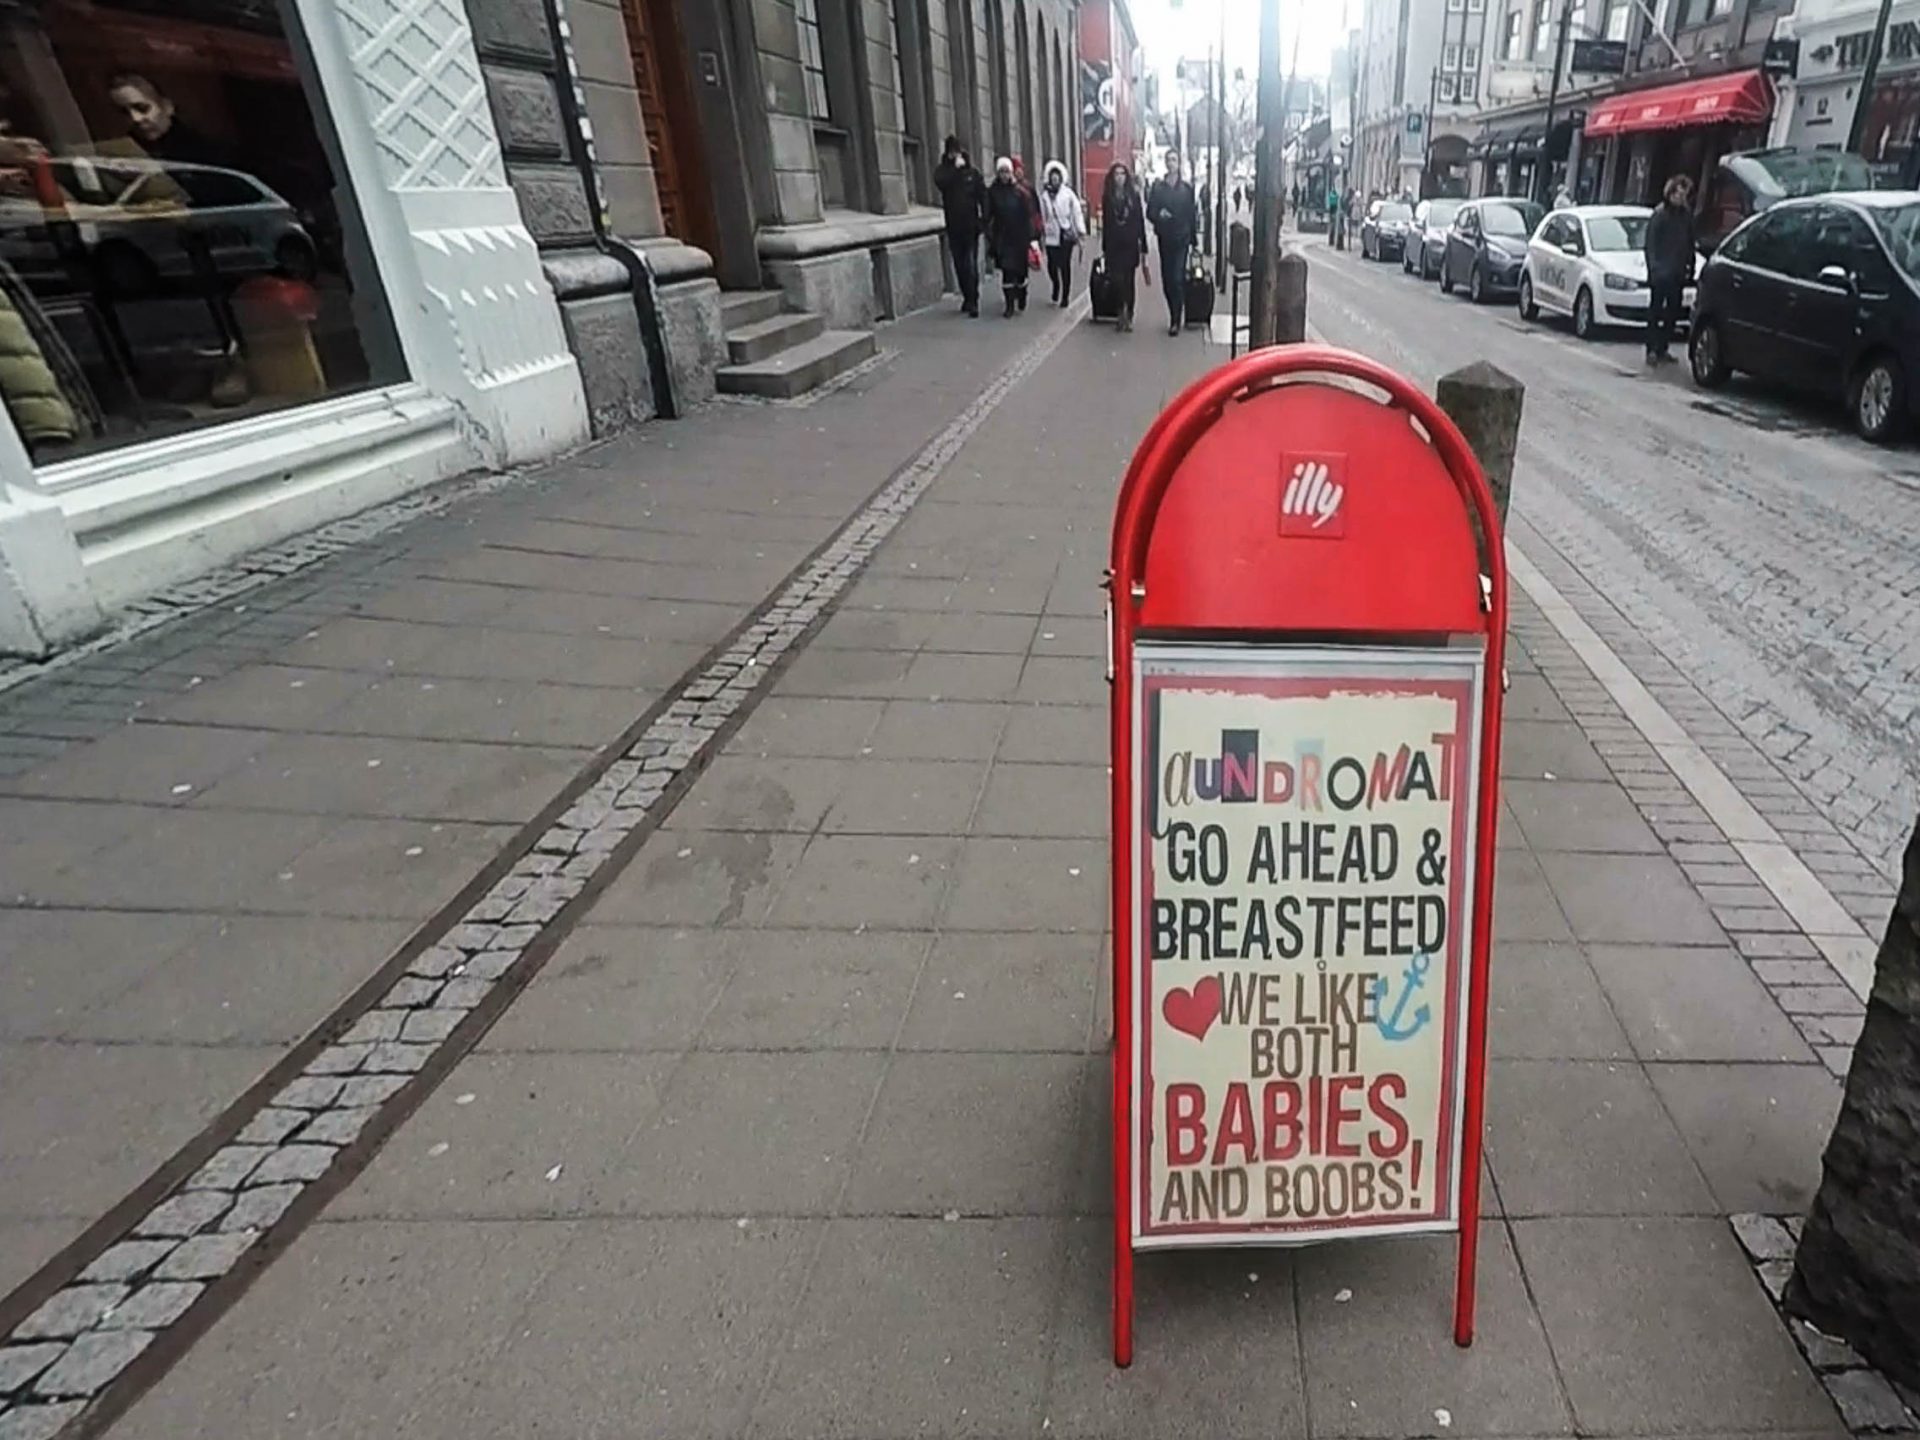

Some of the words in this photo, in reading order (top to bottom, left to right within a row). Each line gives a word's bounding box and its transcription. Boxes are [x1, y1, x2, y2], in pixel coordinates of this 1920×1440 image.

[1282, 461, 1344, 528] illy
[1168, 822, 1229, 886] GO
[1247, 822, 1399, 885] AHEAD
[1415, 827, 1447, 886] &
[1151, 895, 1447, 960] BREASTFEED
[1218, 971, 1281, 1026] WE
[1251, 1024, 1358, 1079] BOTH
[1164, 1073, 1410, 1167] BABIES
[1160, 1166, 1249, 1222] AND
